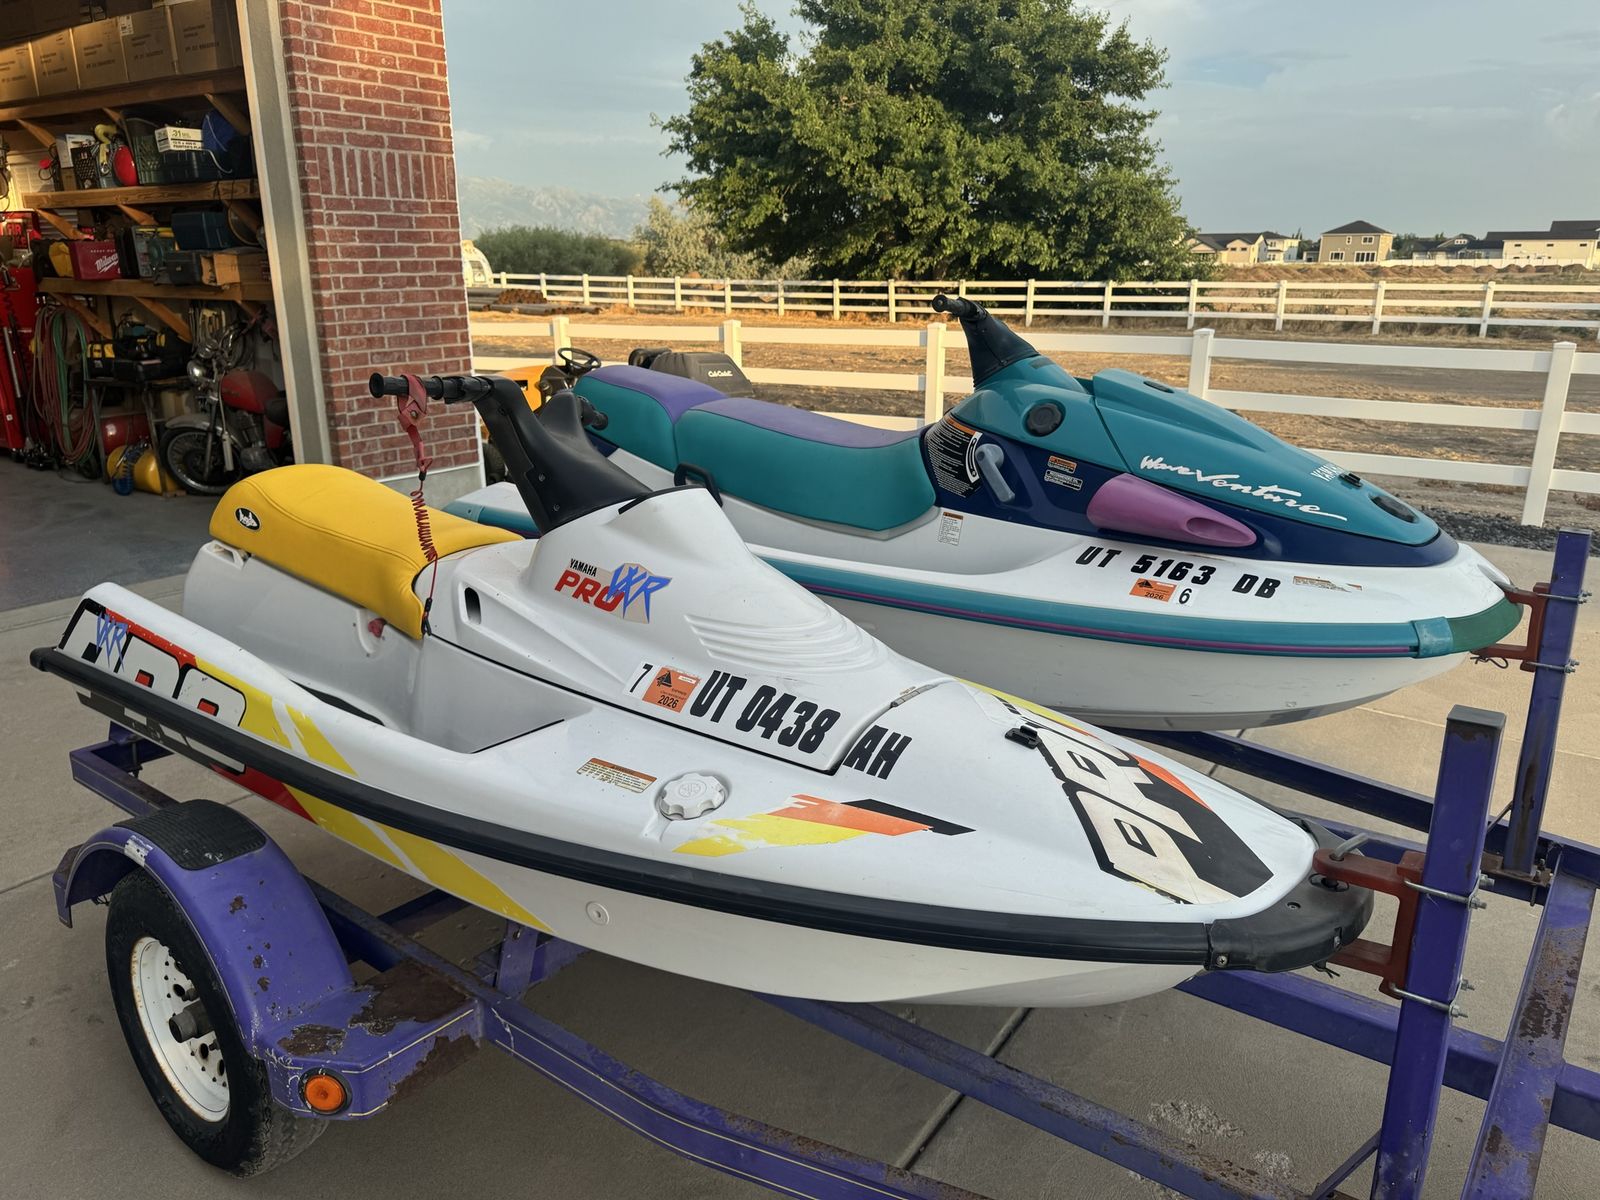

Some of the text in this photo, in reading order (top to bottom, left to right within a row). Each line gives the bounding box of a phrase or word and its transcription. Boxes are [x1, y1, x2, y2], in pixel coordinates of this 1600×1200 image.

[570, 558, 598, 577] YAMAHA
[1075, 545, 1122, 568] UT
[1130, 554, 1217, 585] 5163
[1232, 573, 1281, 599] DB
[554, 569, 625, 612] PRO
[1144, 591, 1164, 600] 2026
[1178, 587, 1193, 605] 6
[629, 663, 654, 693] 7
[657, 694, 679, 709] 2026
[689, 669, 913, 780] UT 0438 AH
